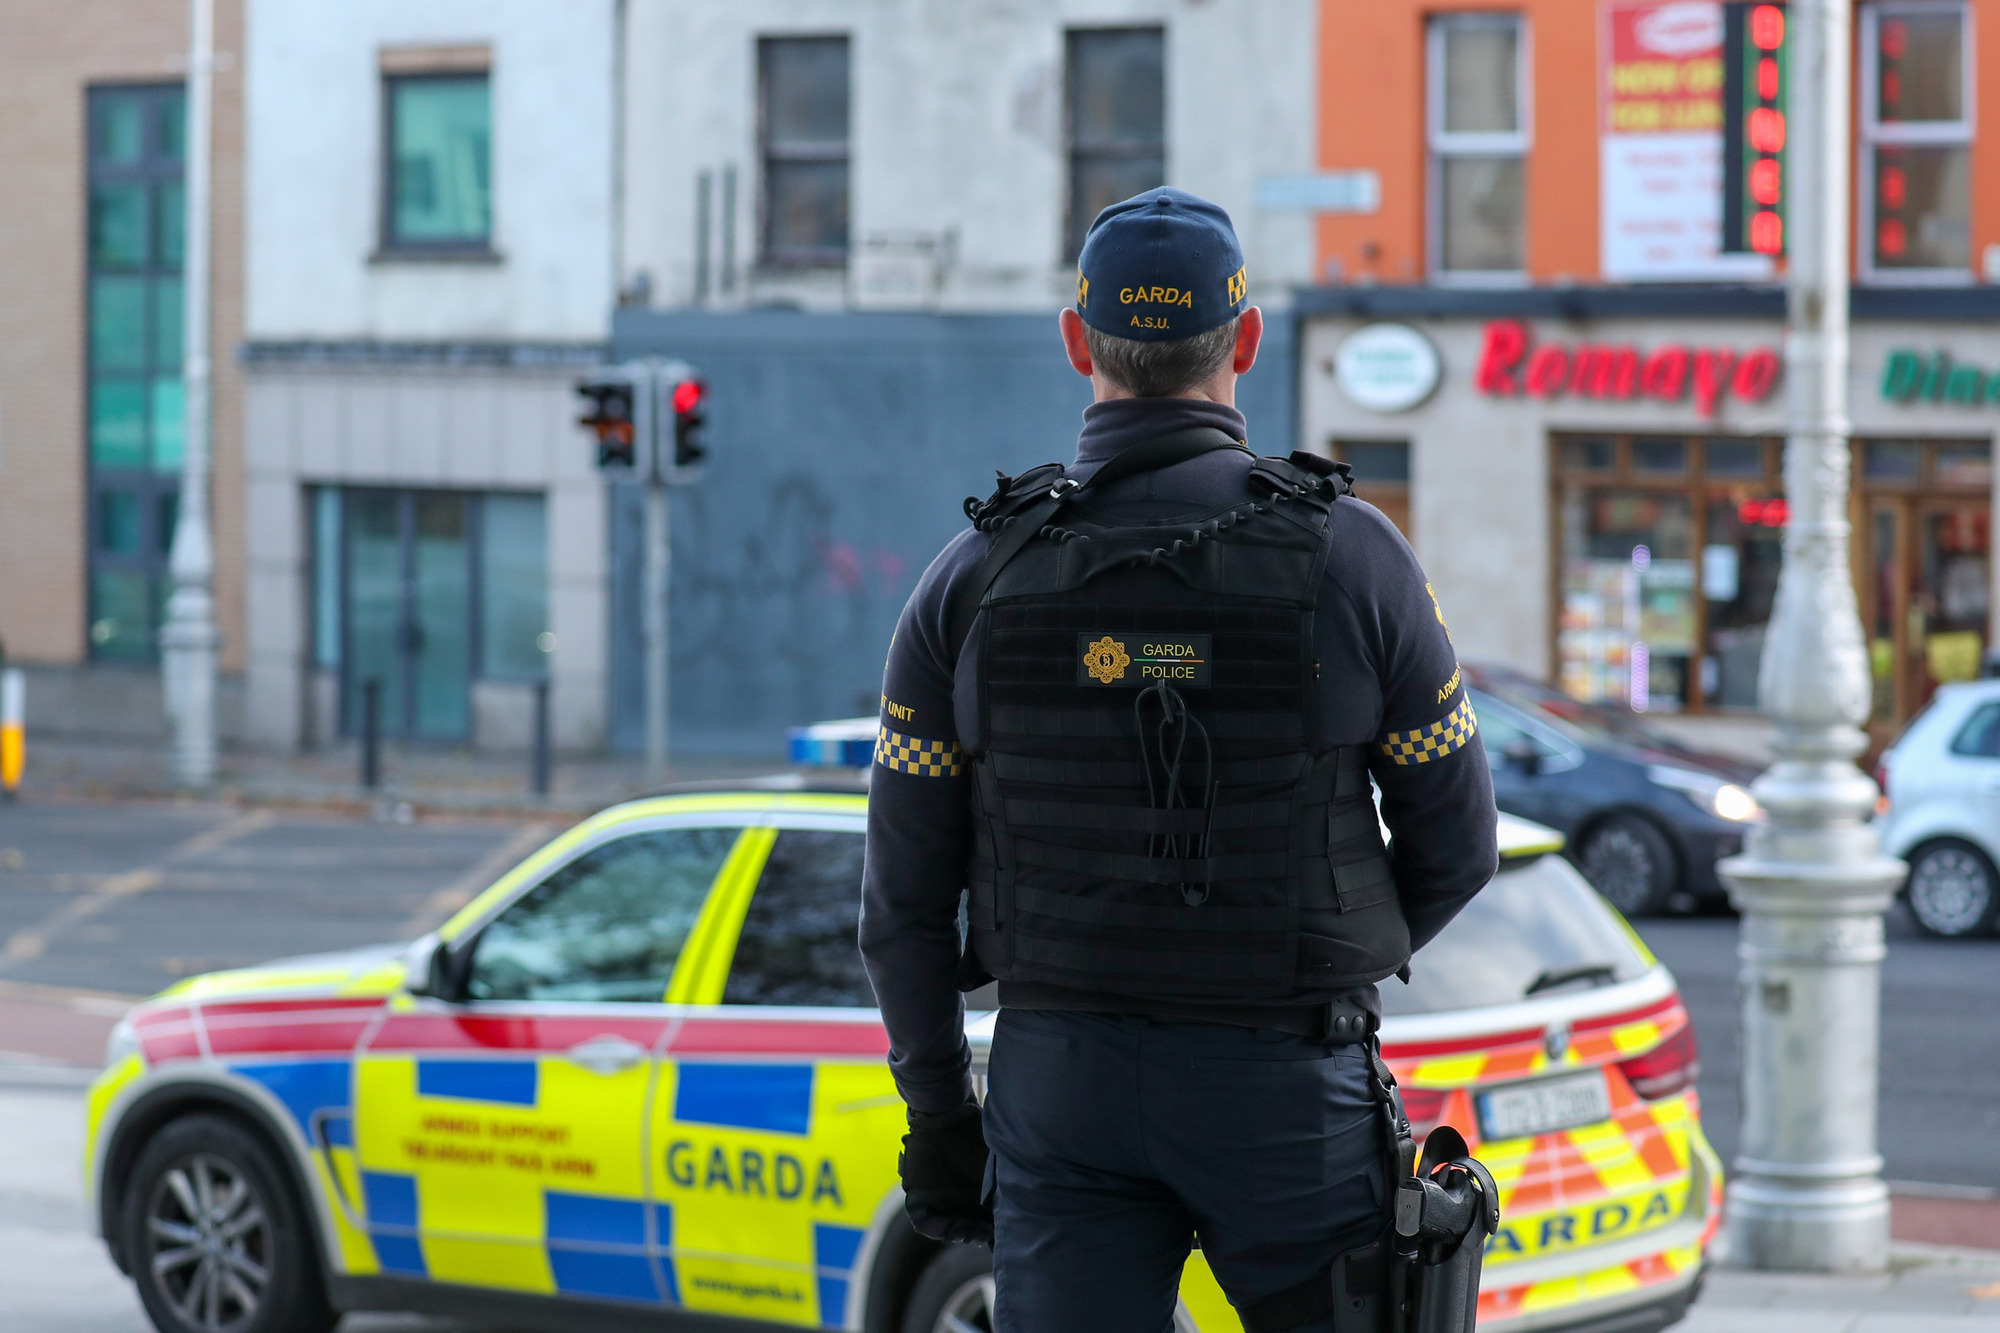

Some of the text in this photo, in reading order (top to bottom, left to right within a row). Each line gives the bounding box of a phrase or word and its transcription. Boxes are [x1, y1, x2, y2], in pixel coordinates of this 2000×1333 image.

[1119, 286, 1192, 308] GARDA
[1130, 315, 1170, 329] A.S.U.
[1475, 319, 1780, 418] Romayo
[1142, 643, 1195, 657] GARDA
[1142, 666, 1195, 679] POLICE
[888, 700, 915, 721] UNIT
[666, 1141, 844, 1207] GARDA
[1484, 1193, 1670, 1255] ARDA
